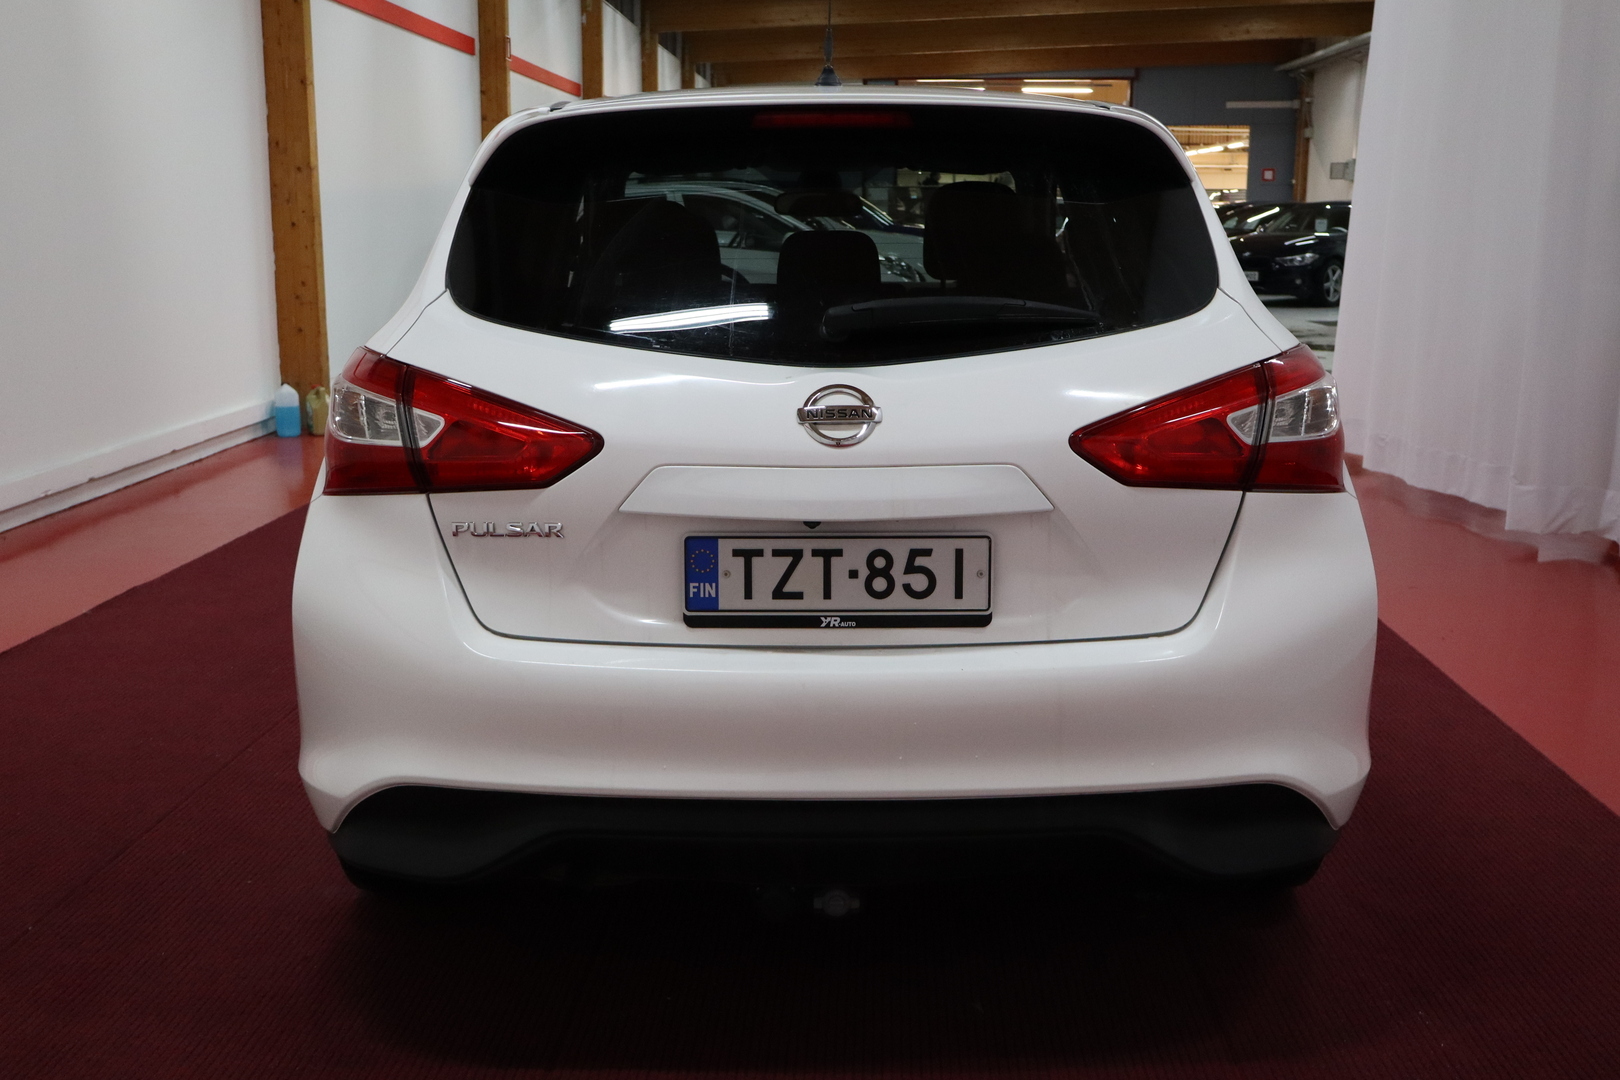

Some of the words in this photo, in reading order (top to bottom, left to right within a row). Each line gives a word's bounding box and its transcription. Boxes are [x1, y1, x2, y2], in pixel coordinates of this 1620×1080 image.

[806, 409, 873, 419] NISSAN
[451, 521, 564, 538] PULSAR
[731, 548, 964, 600] TZT-851
[689, 582, 716, 598] FIN
